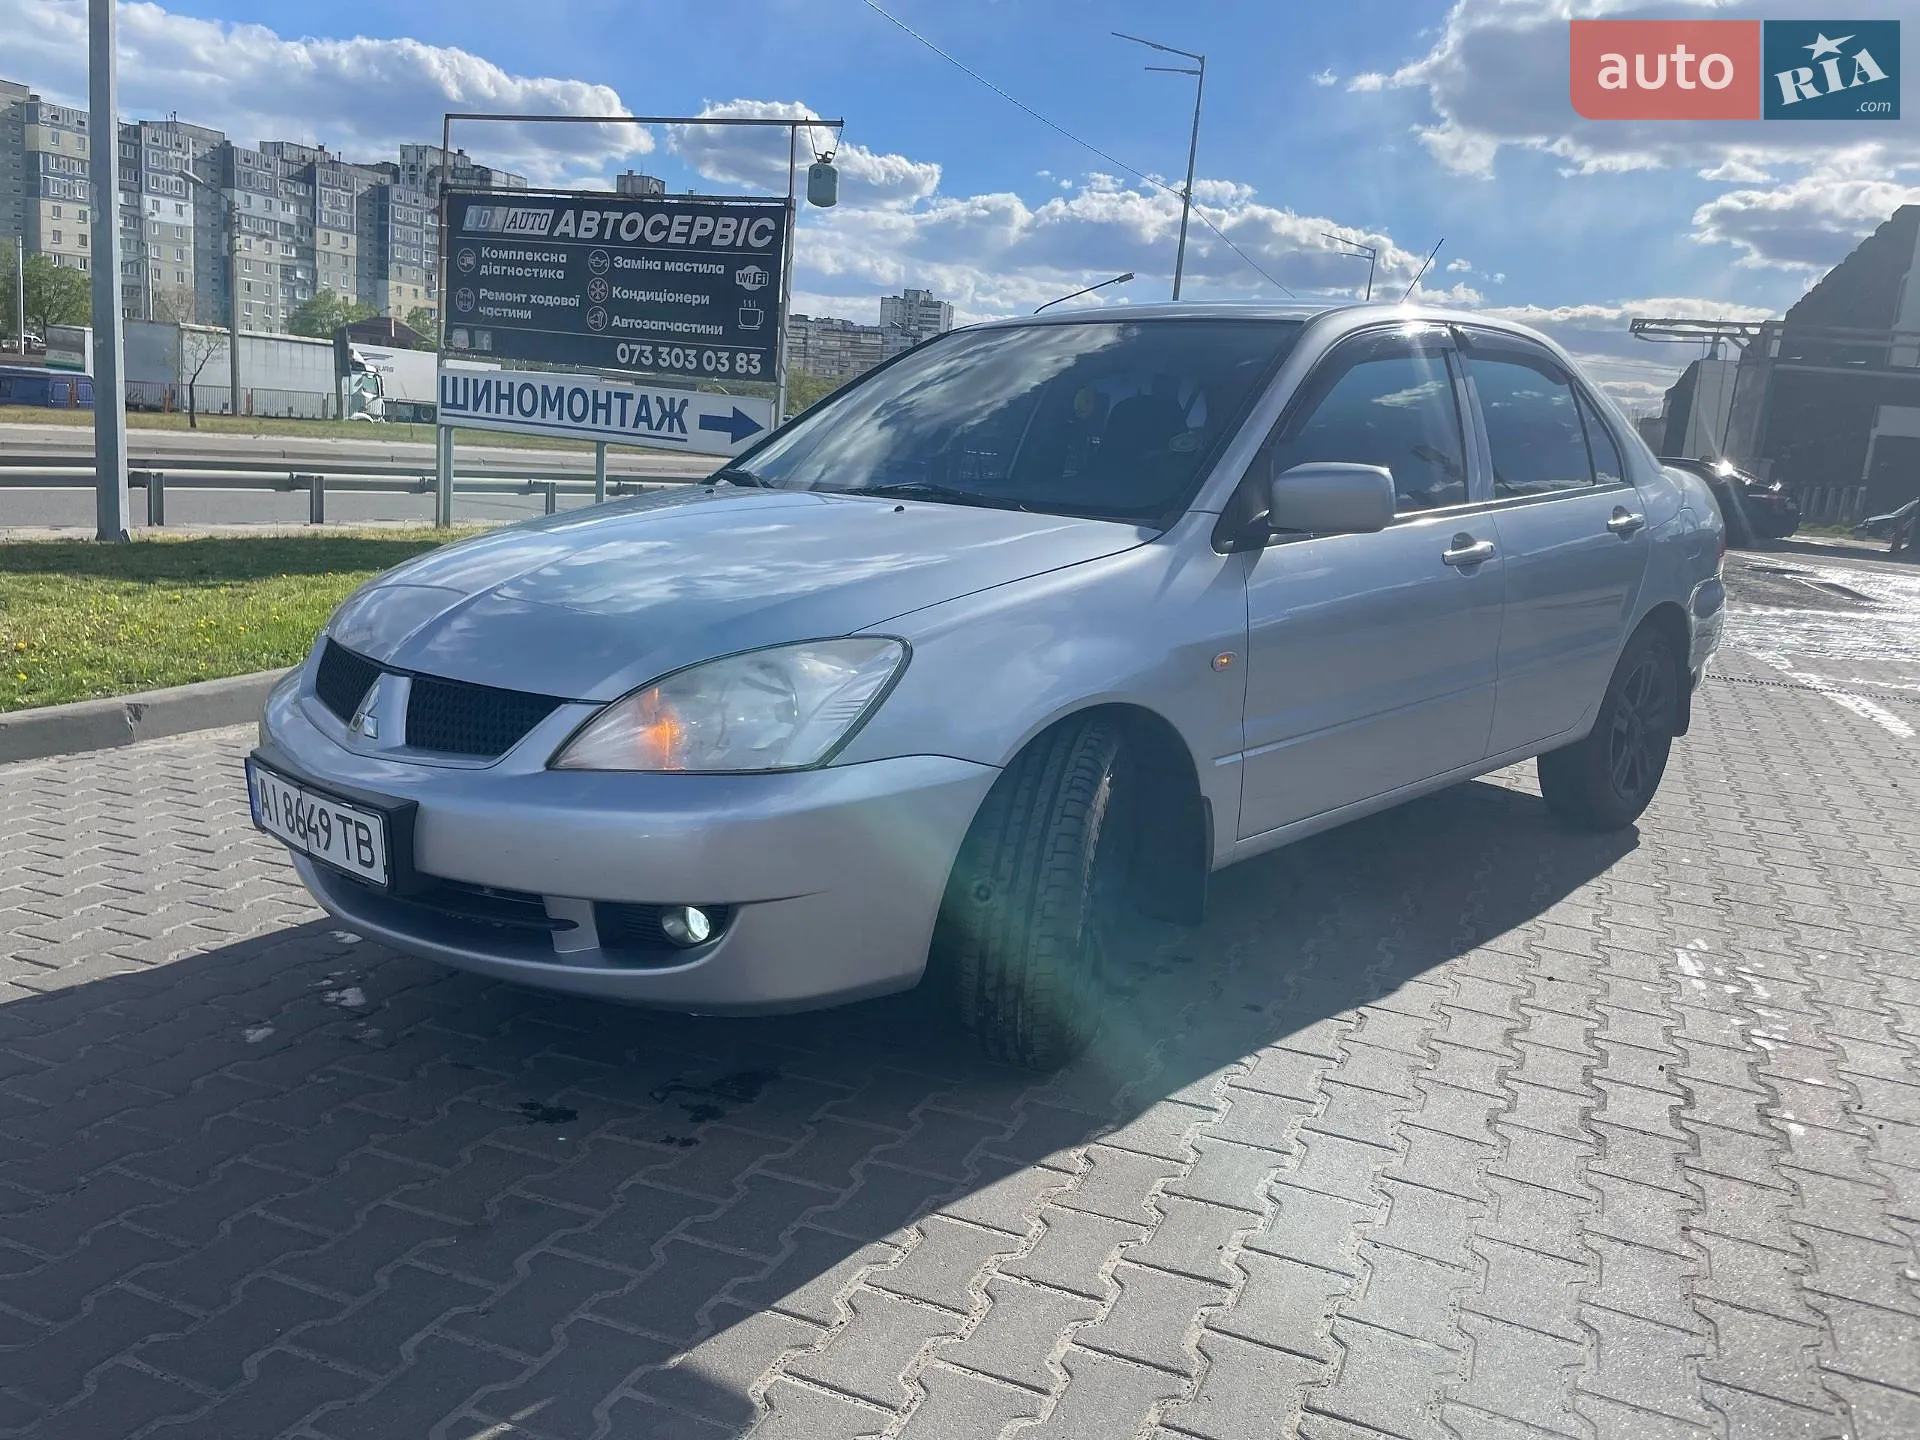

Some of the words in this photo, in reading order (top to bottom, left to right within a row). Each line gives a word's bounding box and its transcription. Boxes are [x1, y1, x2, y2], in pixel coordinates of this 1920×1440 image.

[505, 211, 550, 231] AUTO
[553, 209, 776, 248] АВТОСЕРВІС
[481, 246, 567, 263] Комплексна
[480, 262, 564, 279] діагностика
[613, 255, 661, 271] Заміна
[664, 261, 725, 275] мастила
[479, 288, 527, 302] Ремонт
[530, 294, 580, 307] ходової
[612, 286, 710, 306] Кондиціонери
[478, 306, 532, 319] частини
[611, 315, 723, 336] Автозапчастини
[616, 343, 653, 366] 073
[658, 346, 697, 370] 303
[702, 350, 730, 373] 03
[735, 352, 762, 375] 83
[440, 375, 689, 434] ШИНОМОНТАЖ
[260, 778, 280, 827] AI
[283, 791, 332, 851] 8649
[335, 813, 375, 869] TB
